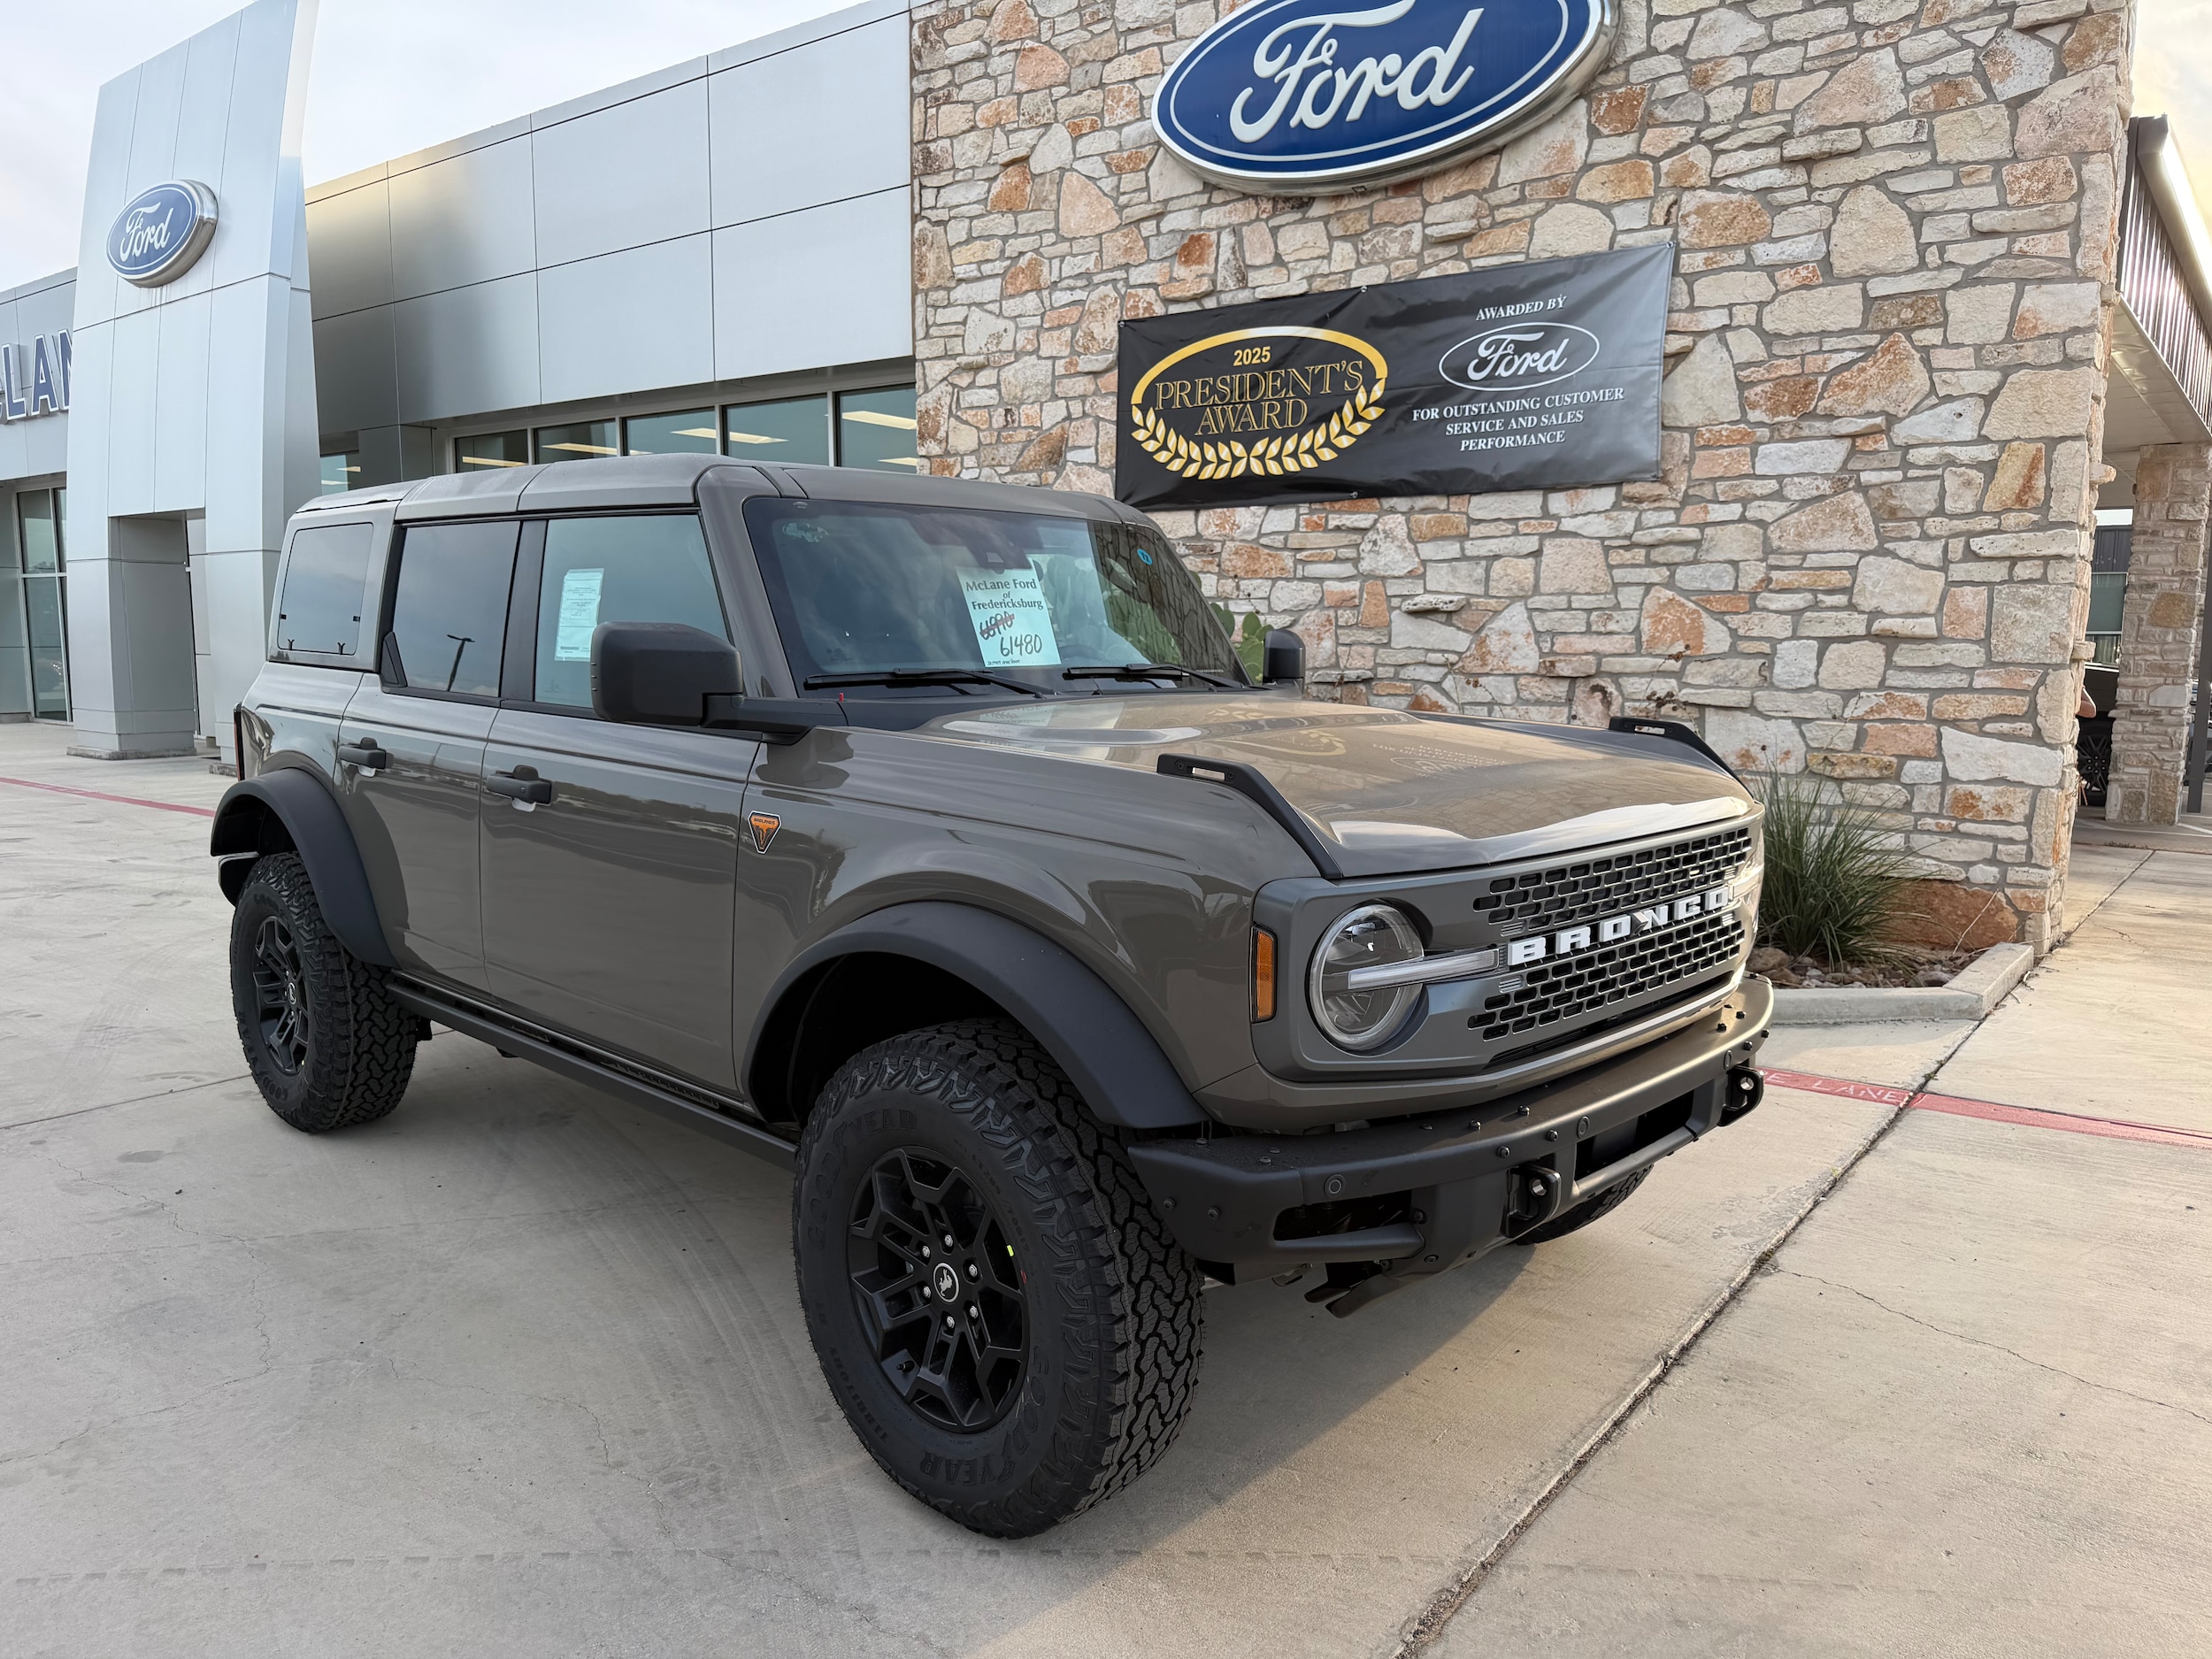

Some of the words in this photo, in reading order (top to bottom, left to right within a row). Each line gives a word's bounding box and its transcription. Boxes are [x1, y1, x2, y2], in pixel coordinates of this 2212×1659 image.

[1230, 0, 1485, 143] Ford
[119, 202, 174, 262] Ford
[1476, 301, 1544, 321] AWARDED
[1547, 295, 1568, 311] BY
[1233, 346, 1271, 366] 2025
[1467, 331, 1570, 381] Ford
[1156, 360, 1363, 411] PRESIDENT'S
[1194, 398, 1309, 436] AWARD
[1412, 408, 1440, 421] FOR
[1443, 397, 1541, 419] OUTSTANDING
[1544, 388, 1625, 408] CUSTOMER
[1446, 419, 1504, 435] SERVICE
[1508, 416, 1538, 430] AND
[1540, 410, 1585, 426] SALES
[1460, 430, 1565, 451] PERFORMANCE
[965, 580, 1010, 592] McLane
[1012, 579, 1038, 590] Ford
[972, 599, 1044, 611] Fredericksburg
[1000, 634, 1042, 657] 61480
[1506, 885, 1731, 967] BRONCO
[1811, 1079, 1902, 1102] LANE
